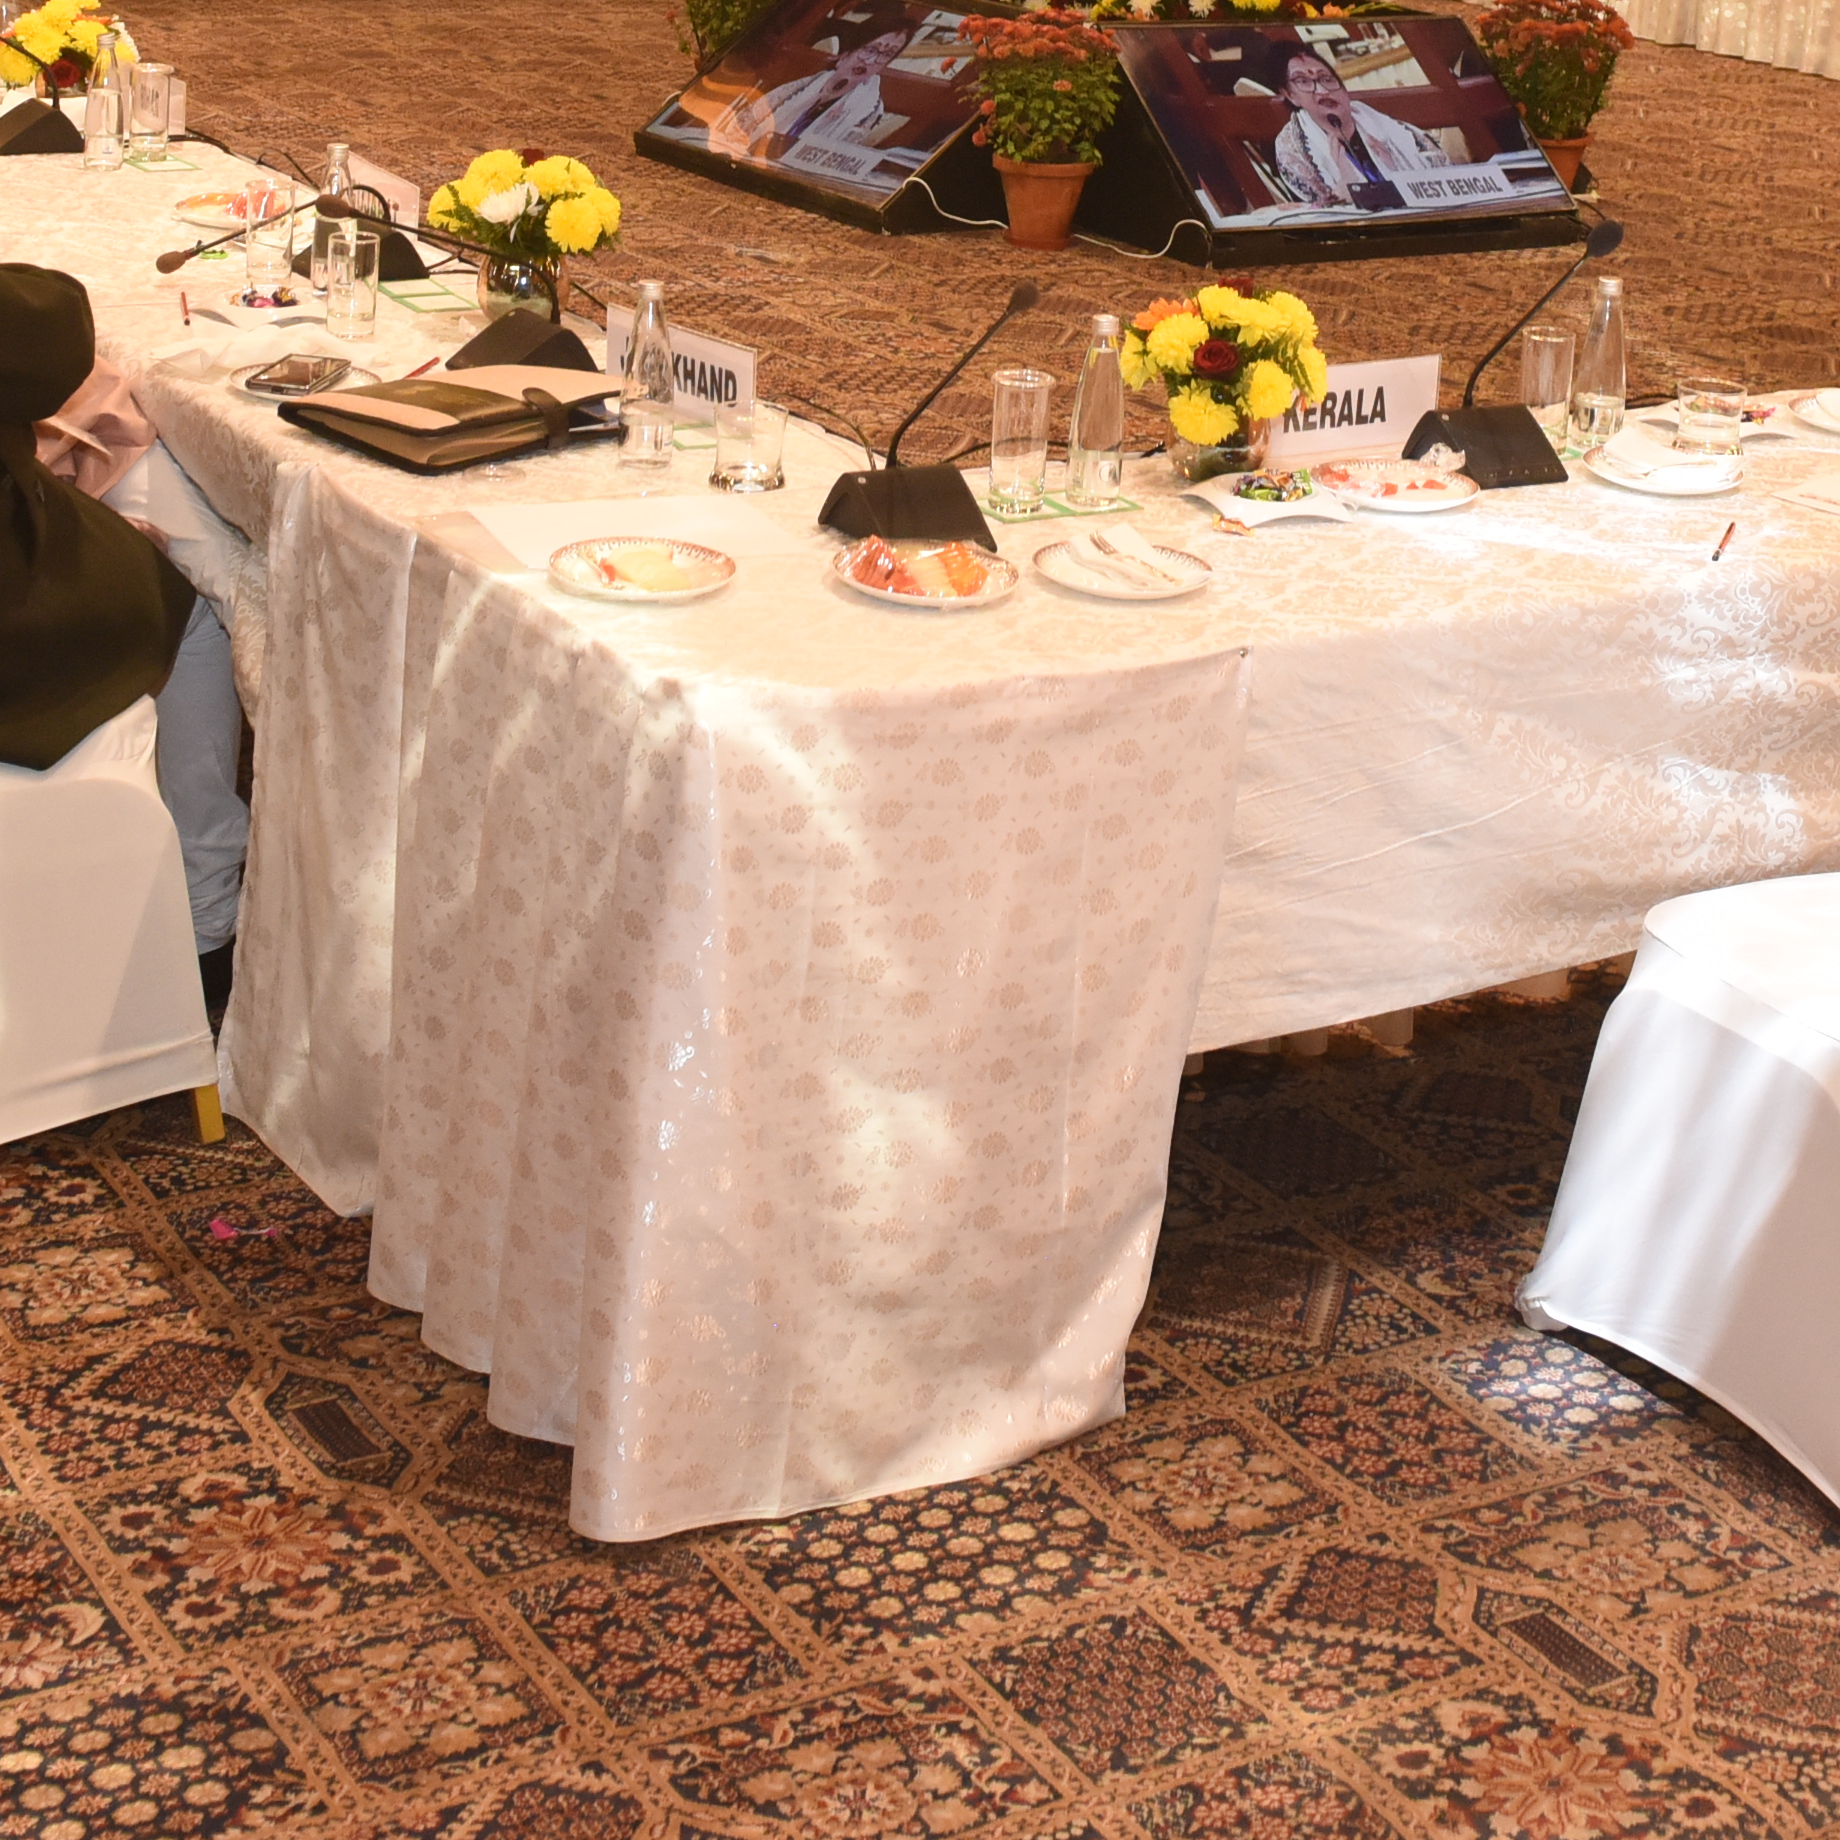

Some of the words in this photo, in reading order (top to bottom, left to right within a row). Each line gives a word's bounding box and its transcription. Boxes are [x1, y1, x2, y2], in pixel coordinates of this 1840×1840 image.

[1406, 180, 1448, 200] WEST
[1445, 176, 1503, 197] BENGAL
[1282, 385, 1387, 433] KERALA
